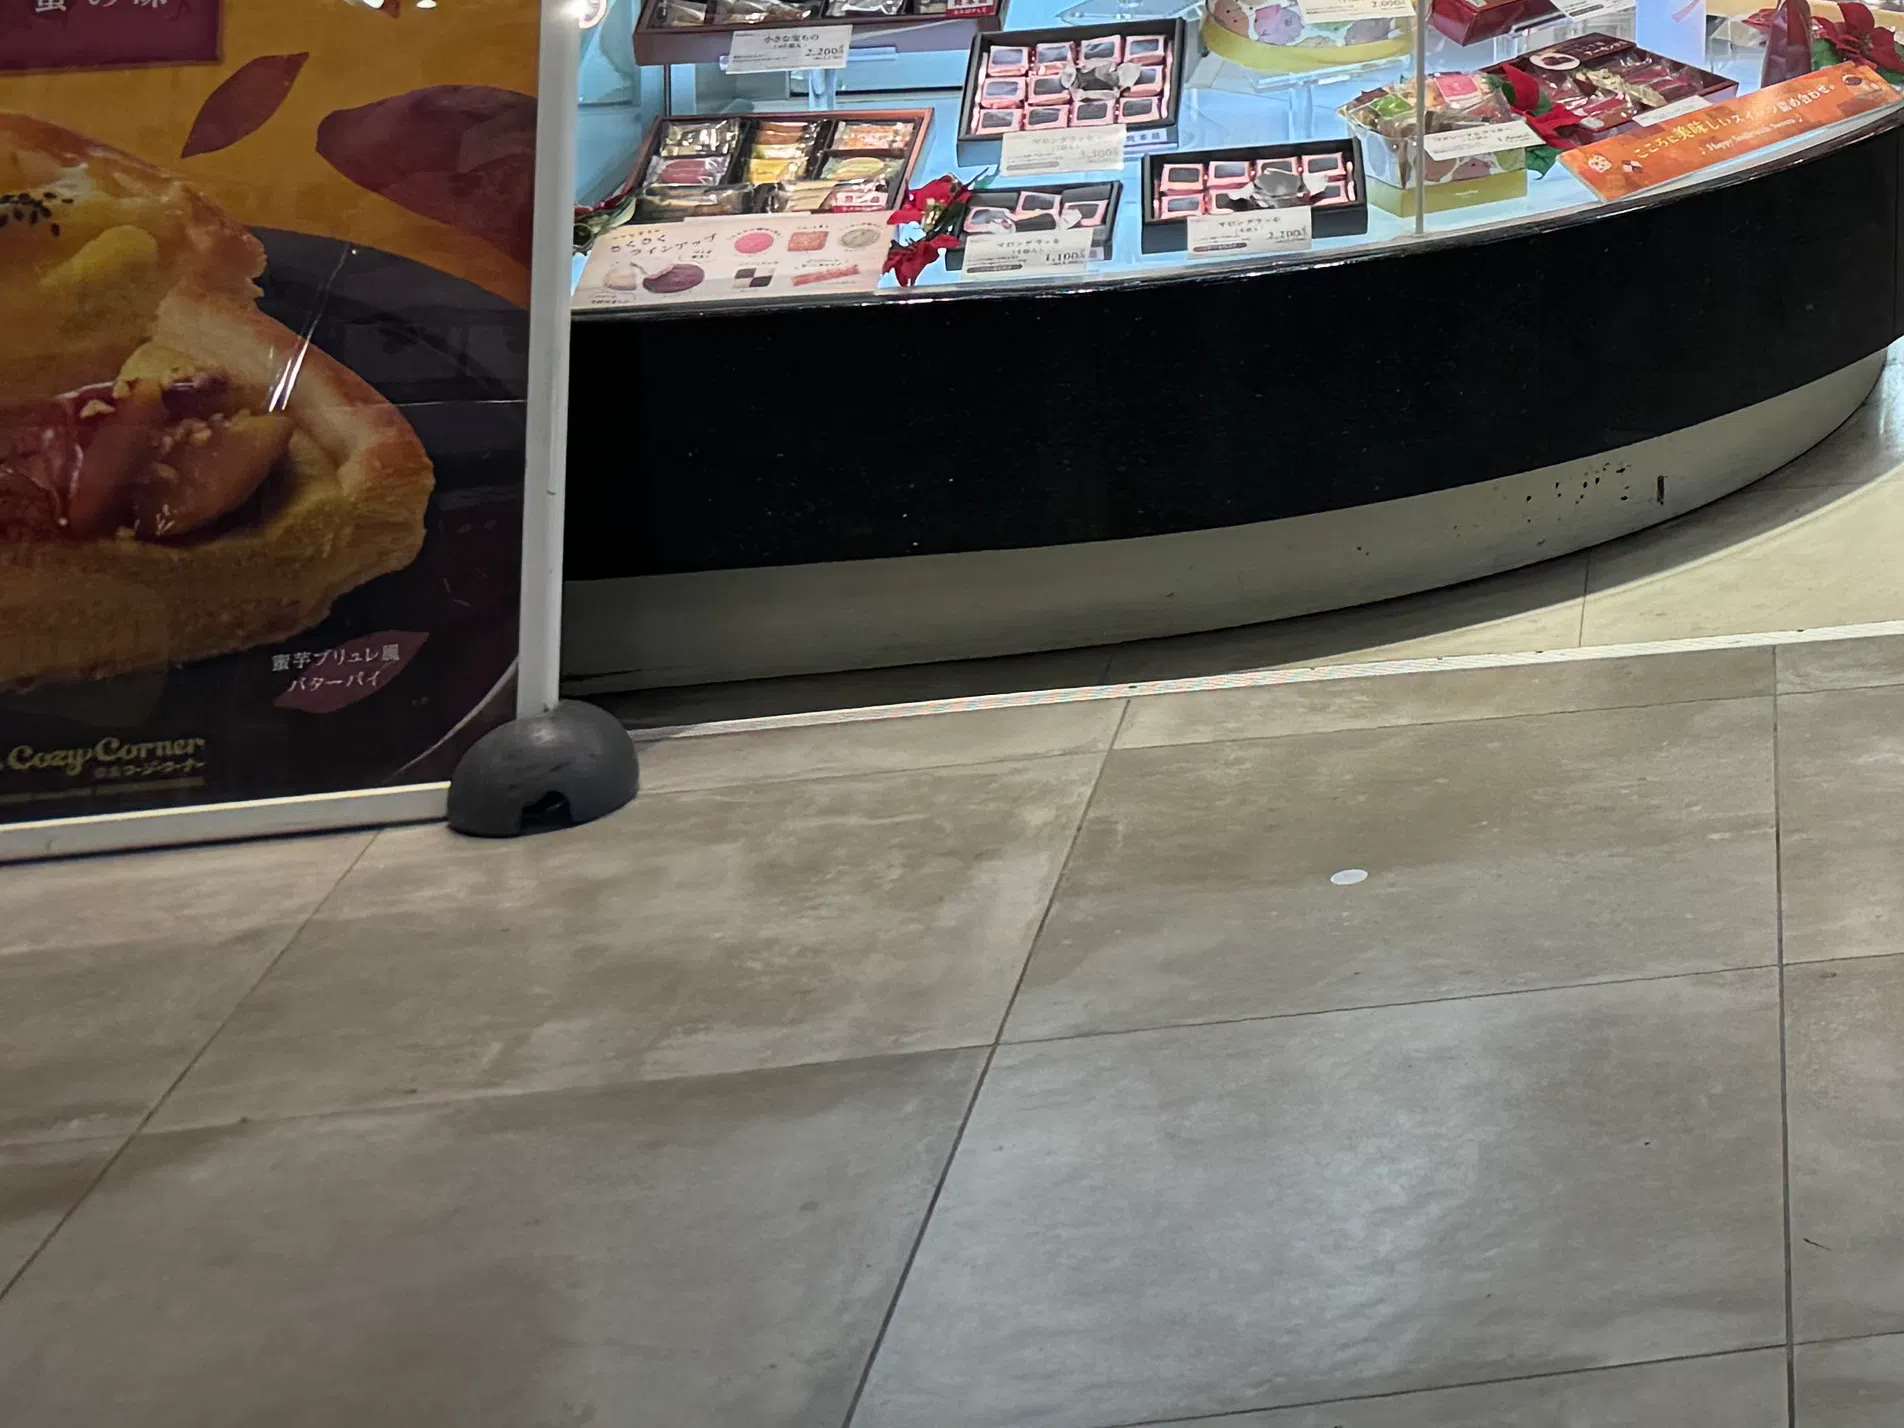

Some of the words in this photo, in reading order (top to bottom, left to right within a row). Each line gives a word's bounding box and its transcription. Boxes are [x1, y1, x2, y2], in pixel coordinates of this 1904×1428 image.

[288, 671, 382, 693] バターパイ
[7, 744, 93, 777] Cozy
[95, 736, 205, 762] Corner
